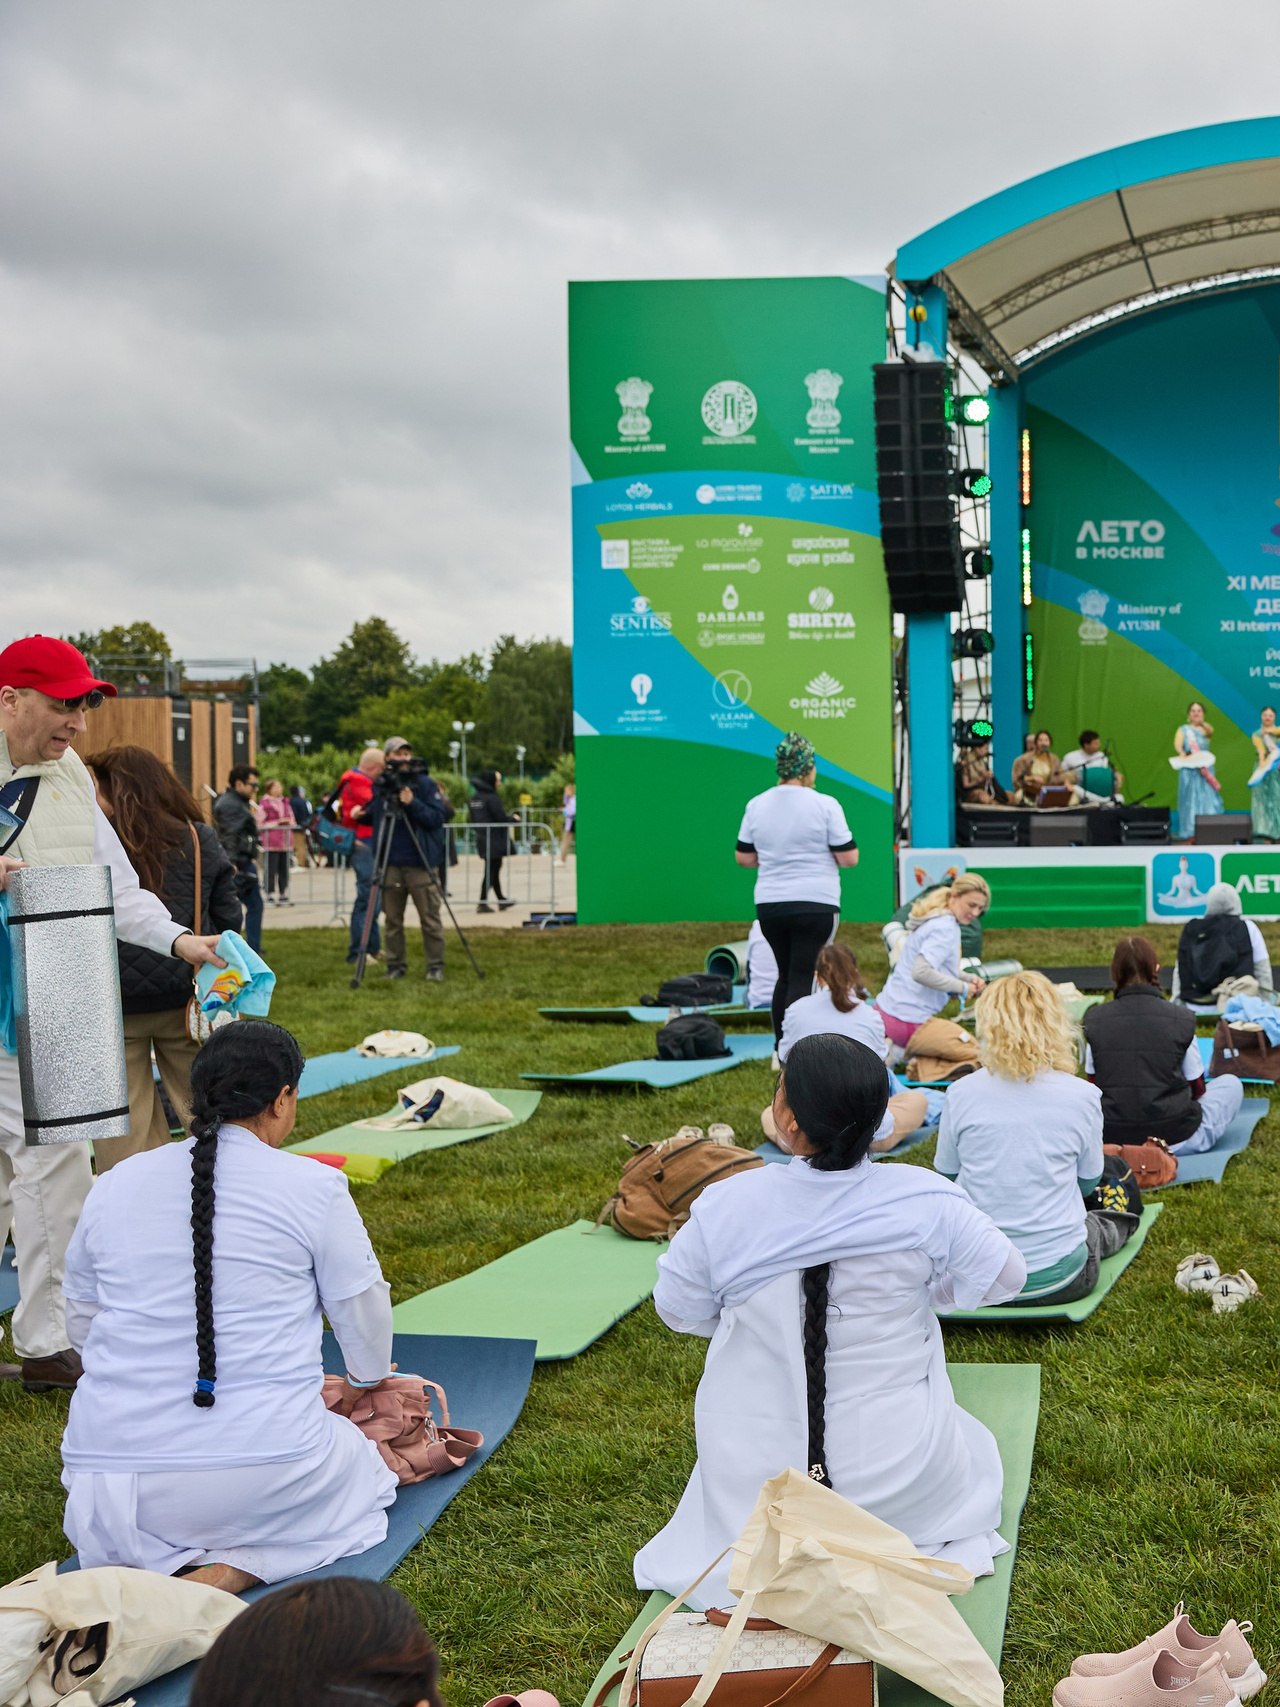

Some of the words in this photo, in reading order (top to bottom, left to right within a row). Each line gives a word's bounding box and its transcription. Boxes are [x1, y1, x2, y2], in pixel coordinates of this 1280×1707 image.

[810, 485, 853, 495] SATTVA
[1077, 519, 1166, 543] ЛЕТО
[1092, 546, 1165, 560] МОСКВЕ
[1117, 604, 1167, 617] Ministry
[1168, 602, 1183, 614] of
[697, 611, 765, 623] DARBARS
[787, 613, 856, 628] SHREYA
[610, 617, 672, 630] SENTISS
[1117, 620, 1161, 631] AYUSH
[1249, 666, 1261, 677] И
[789, 697, 857, 709] ORGANIC
[803, 708, 845, 719] INDIA
